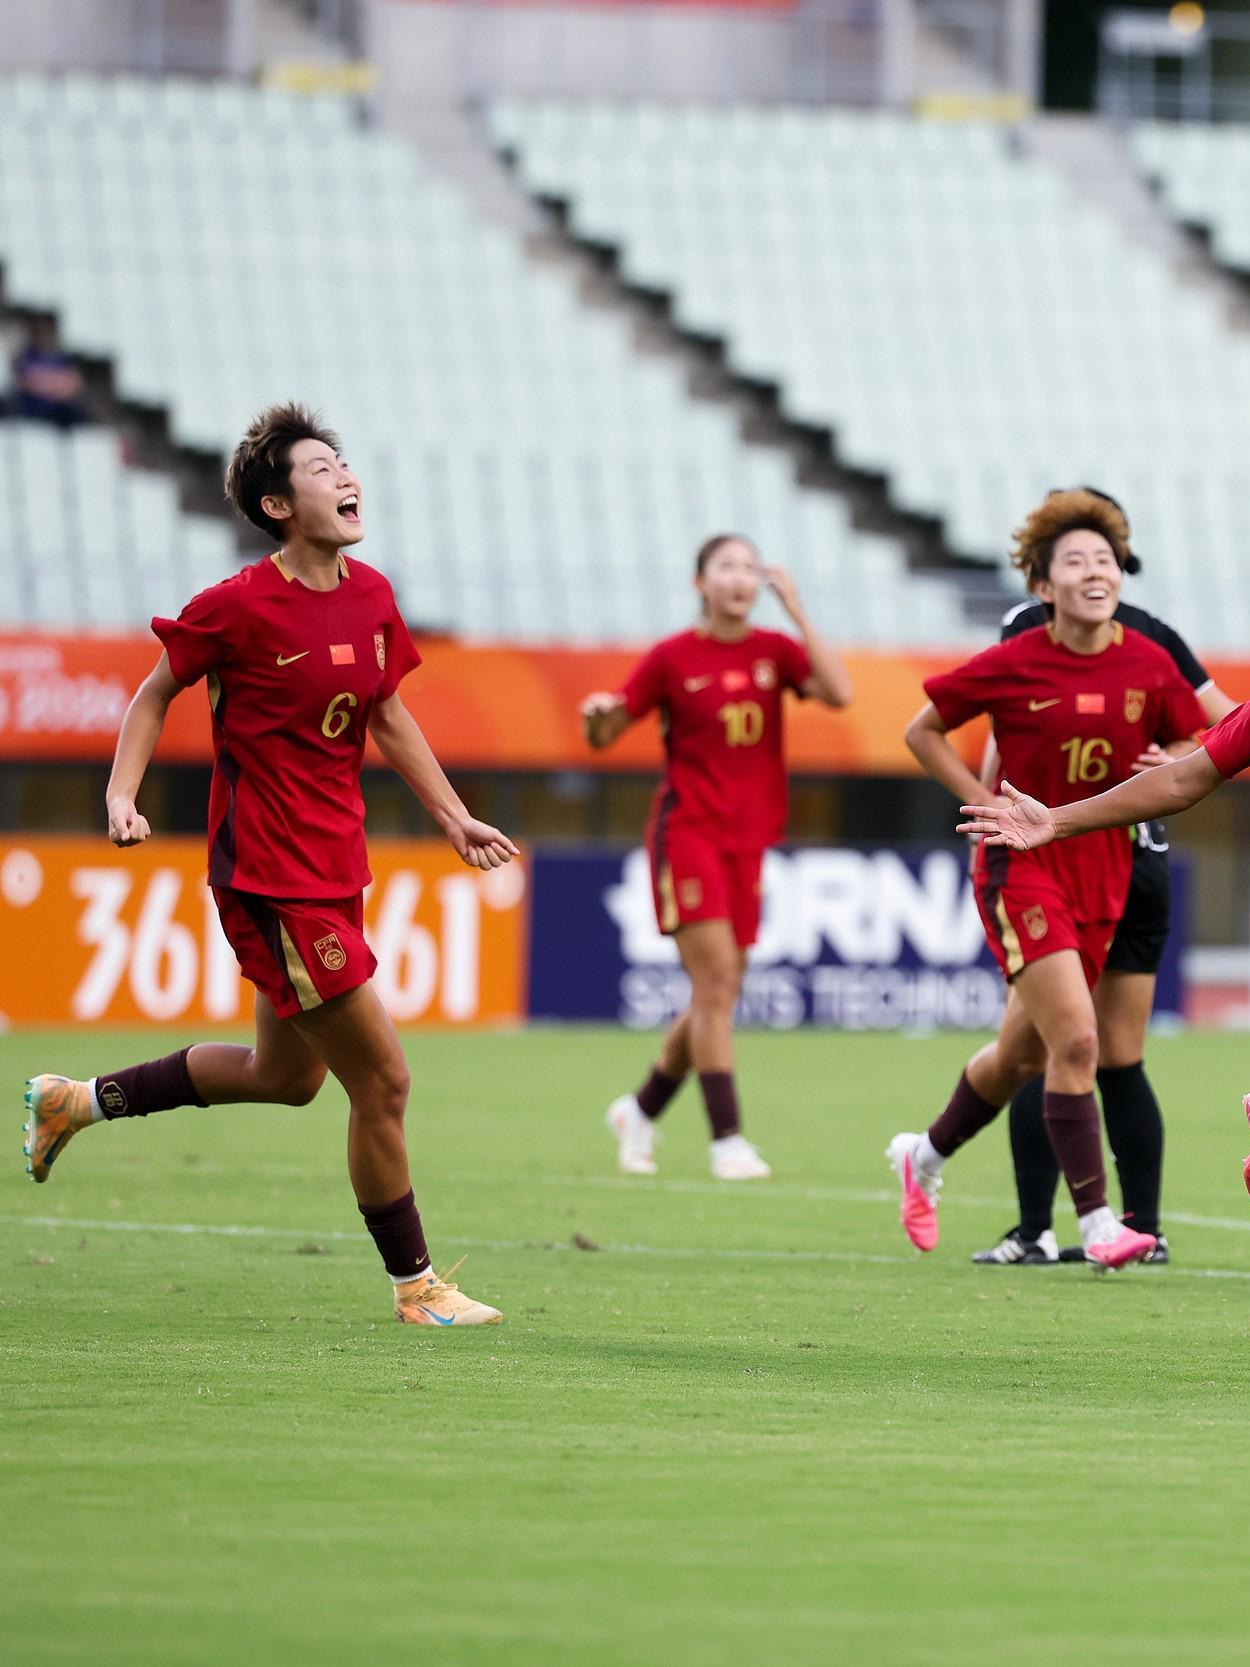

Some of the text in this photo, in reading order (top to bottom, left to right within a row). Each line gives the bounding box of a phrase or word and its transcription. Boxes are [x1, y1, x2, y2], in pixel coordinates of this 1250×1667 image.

[322, 692, 357, 739] 6
[717, 701, 764, 748] 10
[1060, 736, 1113, 784] 16
